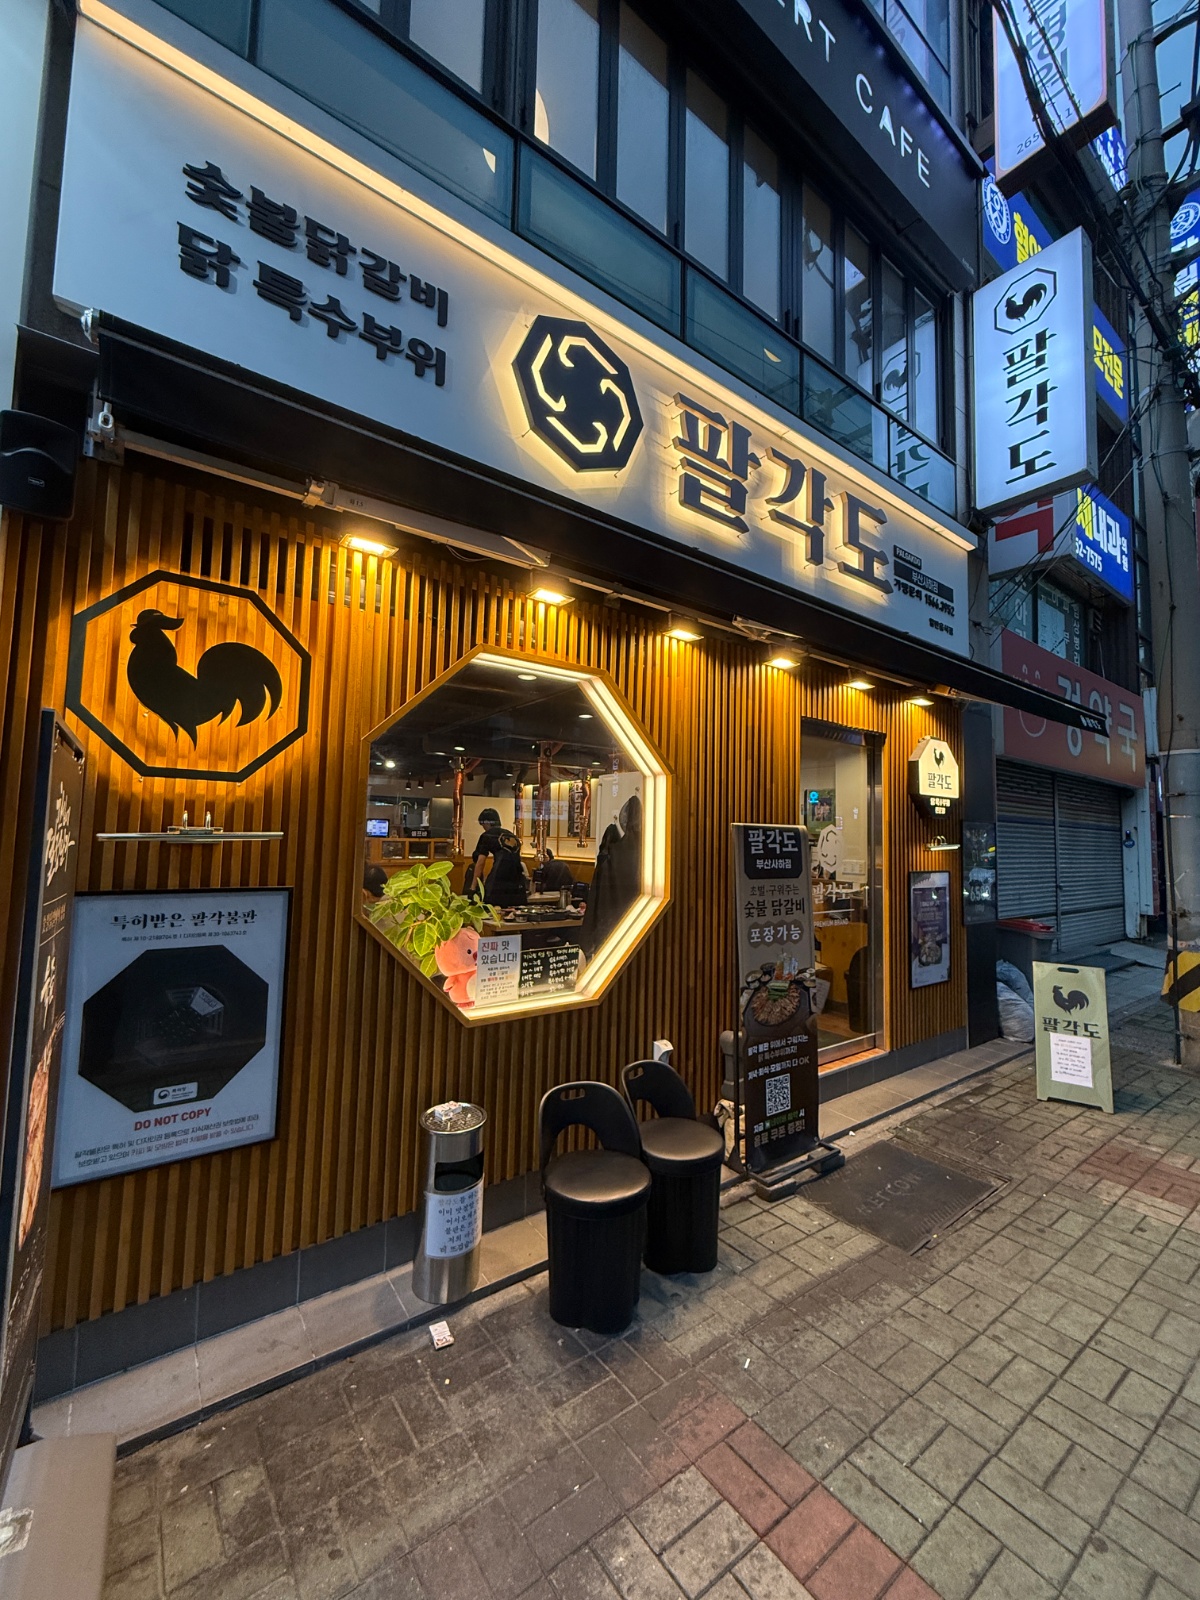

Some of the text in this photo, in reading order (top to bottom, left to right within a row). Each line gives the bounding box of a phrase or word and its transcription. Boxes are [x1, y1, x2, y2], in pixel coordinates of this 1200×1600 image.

[777, 0, 931, 188] RT CAFE
[182, 160, 449, 327] 숯불닭갈비
[177, 221, 446, 387] 닭 특수부위
[1002, 327, 1057, 485] 팔각도
[672, 392, 893, 594] 팔각도
[928, 772, 952, 790] 팔각도
[748, 829, 799, 855] 팔각도
[756, 859, 792, 869] 부산사하점
[812, 881, 851, 905] 팔각도
[744, 897, 805, 918] 숯불 닭갈비
[110, 909, 258, 930] 특허받은 팔각불판
[502, 940, 510, 950] 맛
[750, 925, 802, 943] 포장가능
[481, 952, 517, 965] 있습니다!
[1042, 1016, 1102, 1039] 팔각도
[770, 1037, 785, 1049] 위에서
[786, 1032, 808, 1046] 구워지는
[792, 1058, 797, 1066] 다
[799, 1055, 809, 1065] OK
[134, 1107, 212, 1131] DO NOT COPY
[754, 1118, 805, 1148] 음료 쿠폰 증정!
